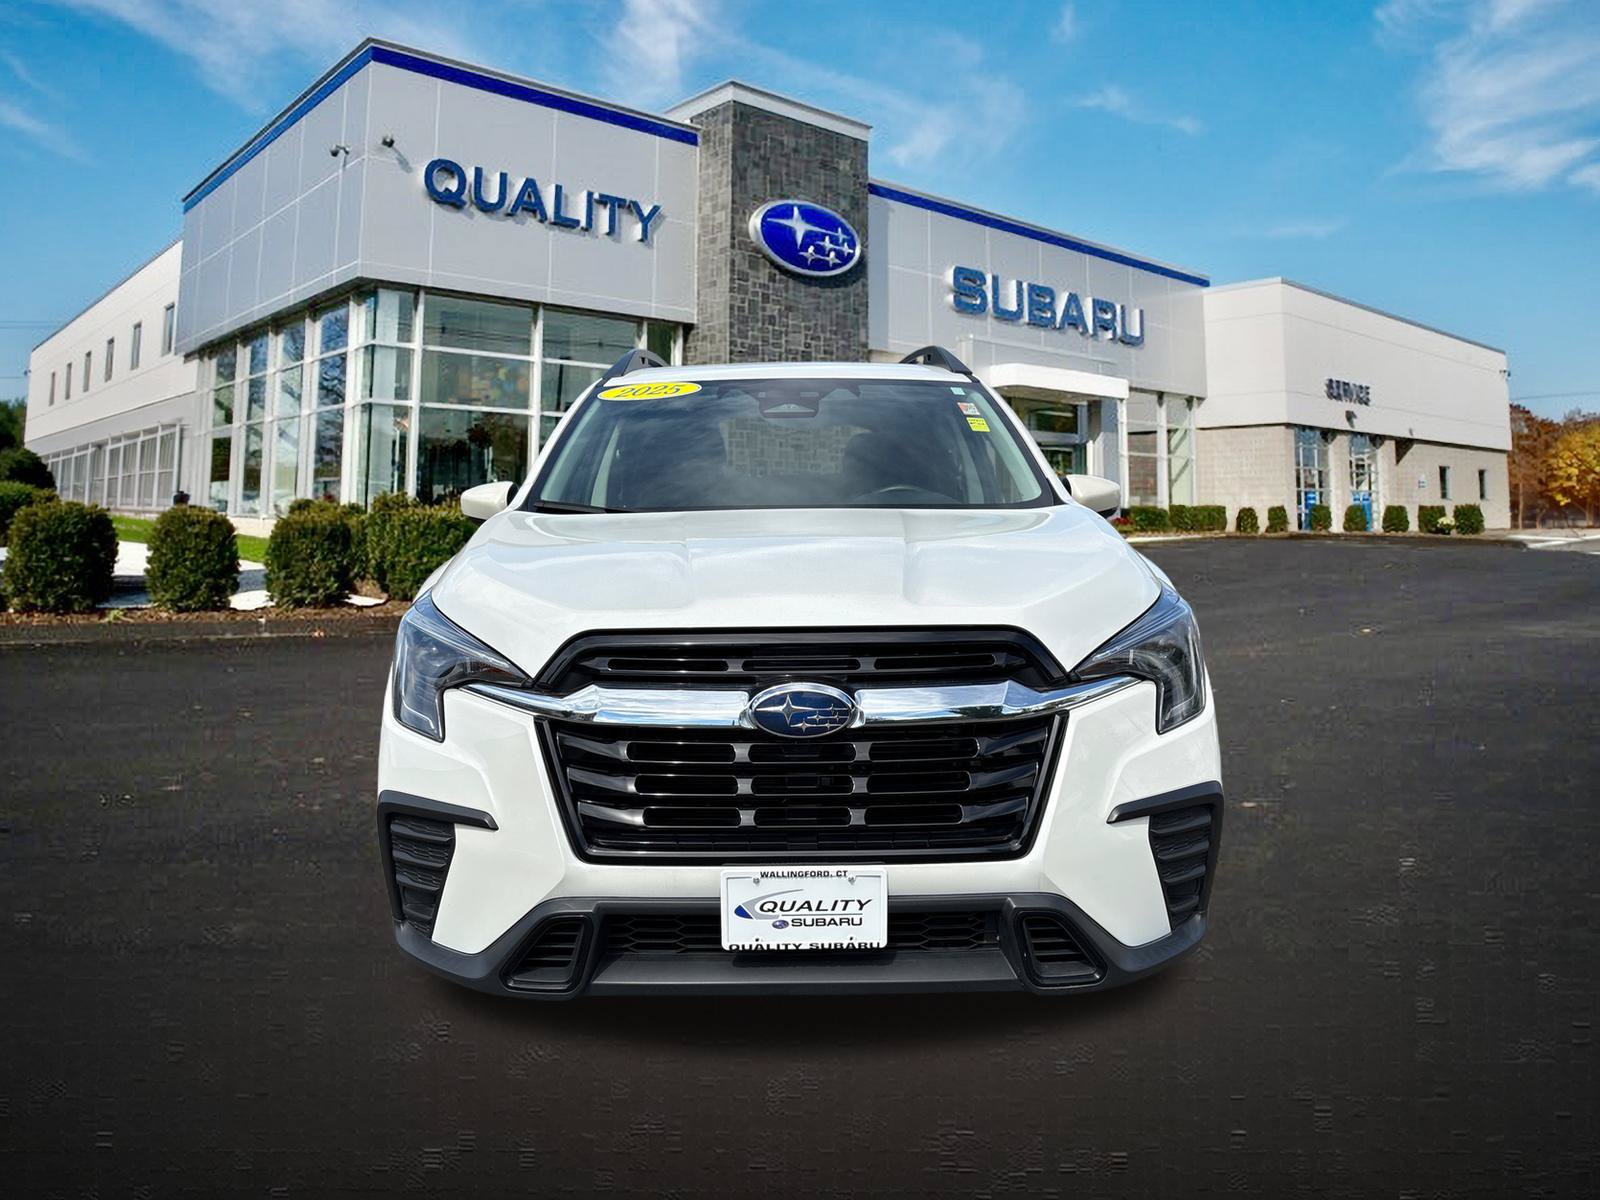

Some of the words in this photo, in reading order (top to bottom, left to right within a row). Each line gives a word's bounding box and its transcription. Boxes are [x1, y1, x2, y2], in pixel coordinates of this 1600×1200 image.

[424, 158, 661, 242] QUALITY
[950, 265, 1144, 346] SUBARU
[616, 383, 686, 398] 2025
[1325, 378, 1371, 406] SERVICE
[836, 870, 848, 878] CT
[759, 899, 872, 913] QUALITY
[791, 918, 863, 927] SUBARU
[809, 942, 880, 950] SUBARU
